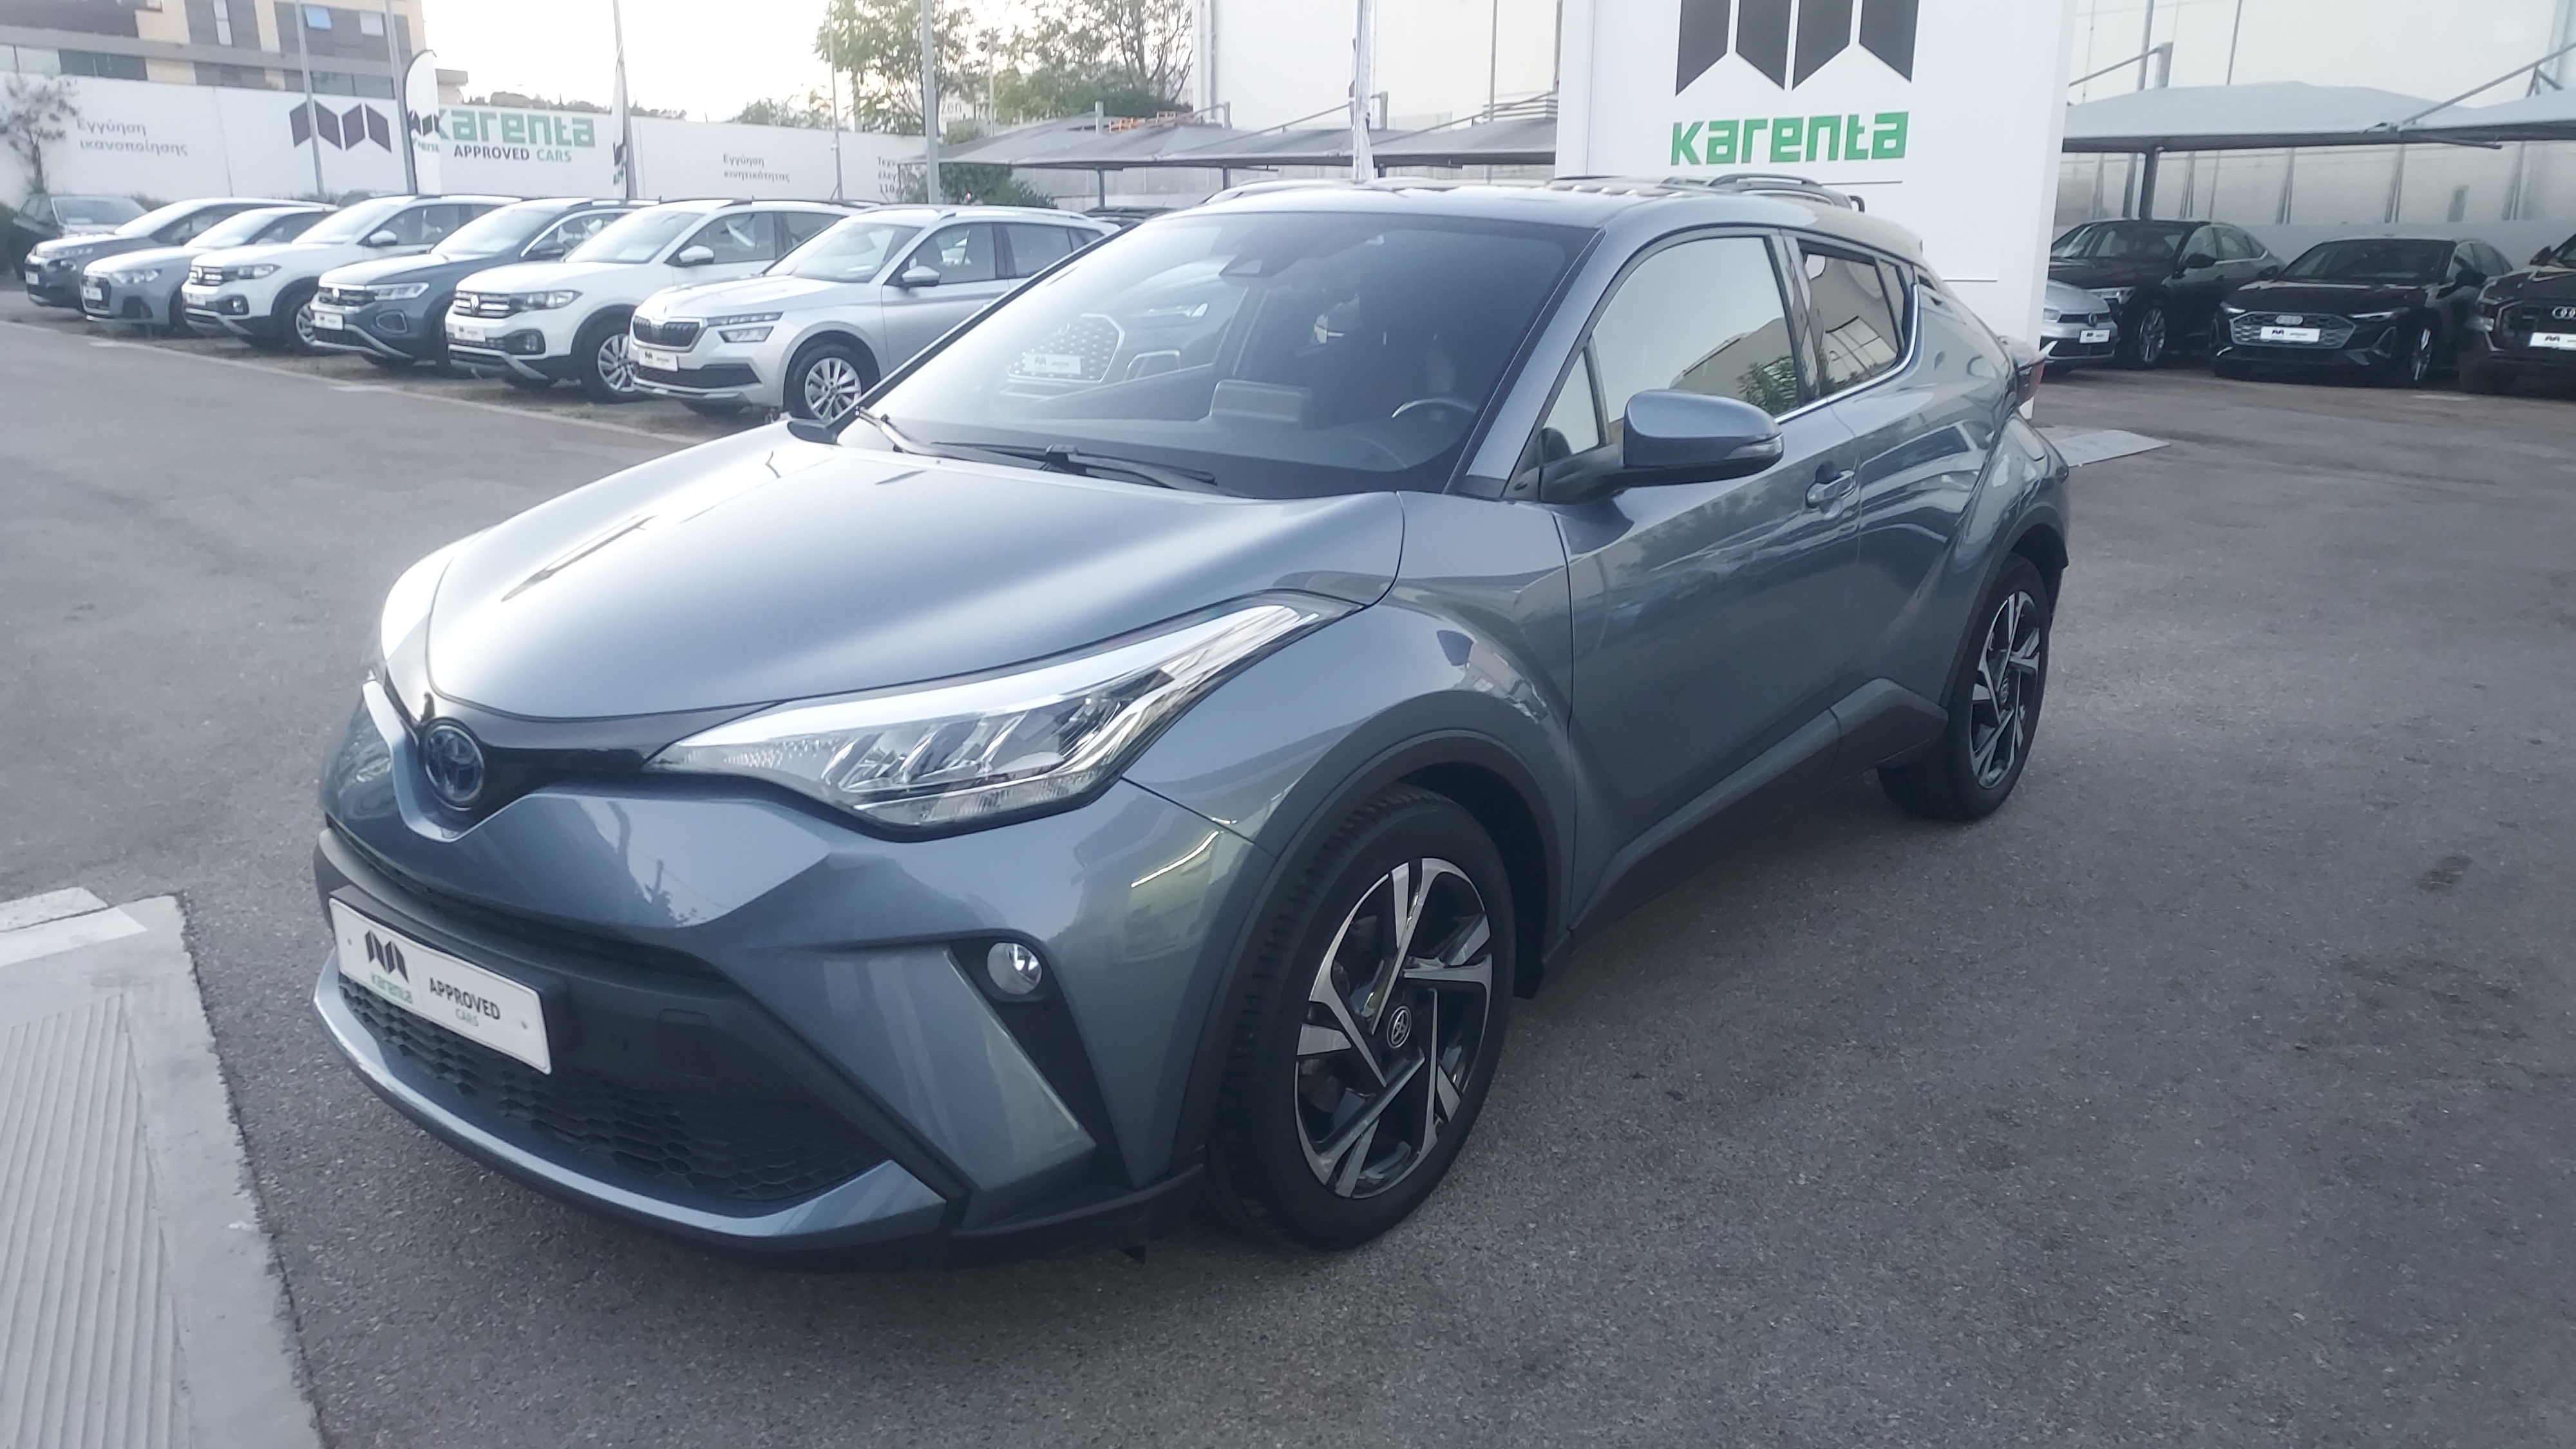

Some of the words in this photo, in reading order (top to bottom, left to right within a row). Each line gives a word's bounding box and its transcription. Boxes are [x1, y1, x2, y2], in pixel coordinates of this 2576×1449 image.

[77, 118, 147, 137] Εγγύηση
[80, 140, 188, 156] ικανοποίησης
[454, 144, 530, 160] APPROVED
[536, 149, 572, 162] CARS
[723, 154, 764, 168] Εγγύηση
[724, 171, 790, 183] κινητικότητας
[430, 976, 501, 1021] APPROVED
